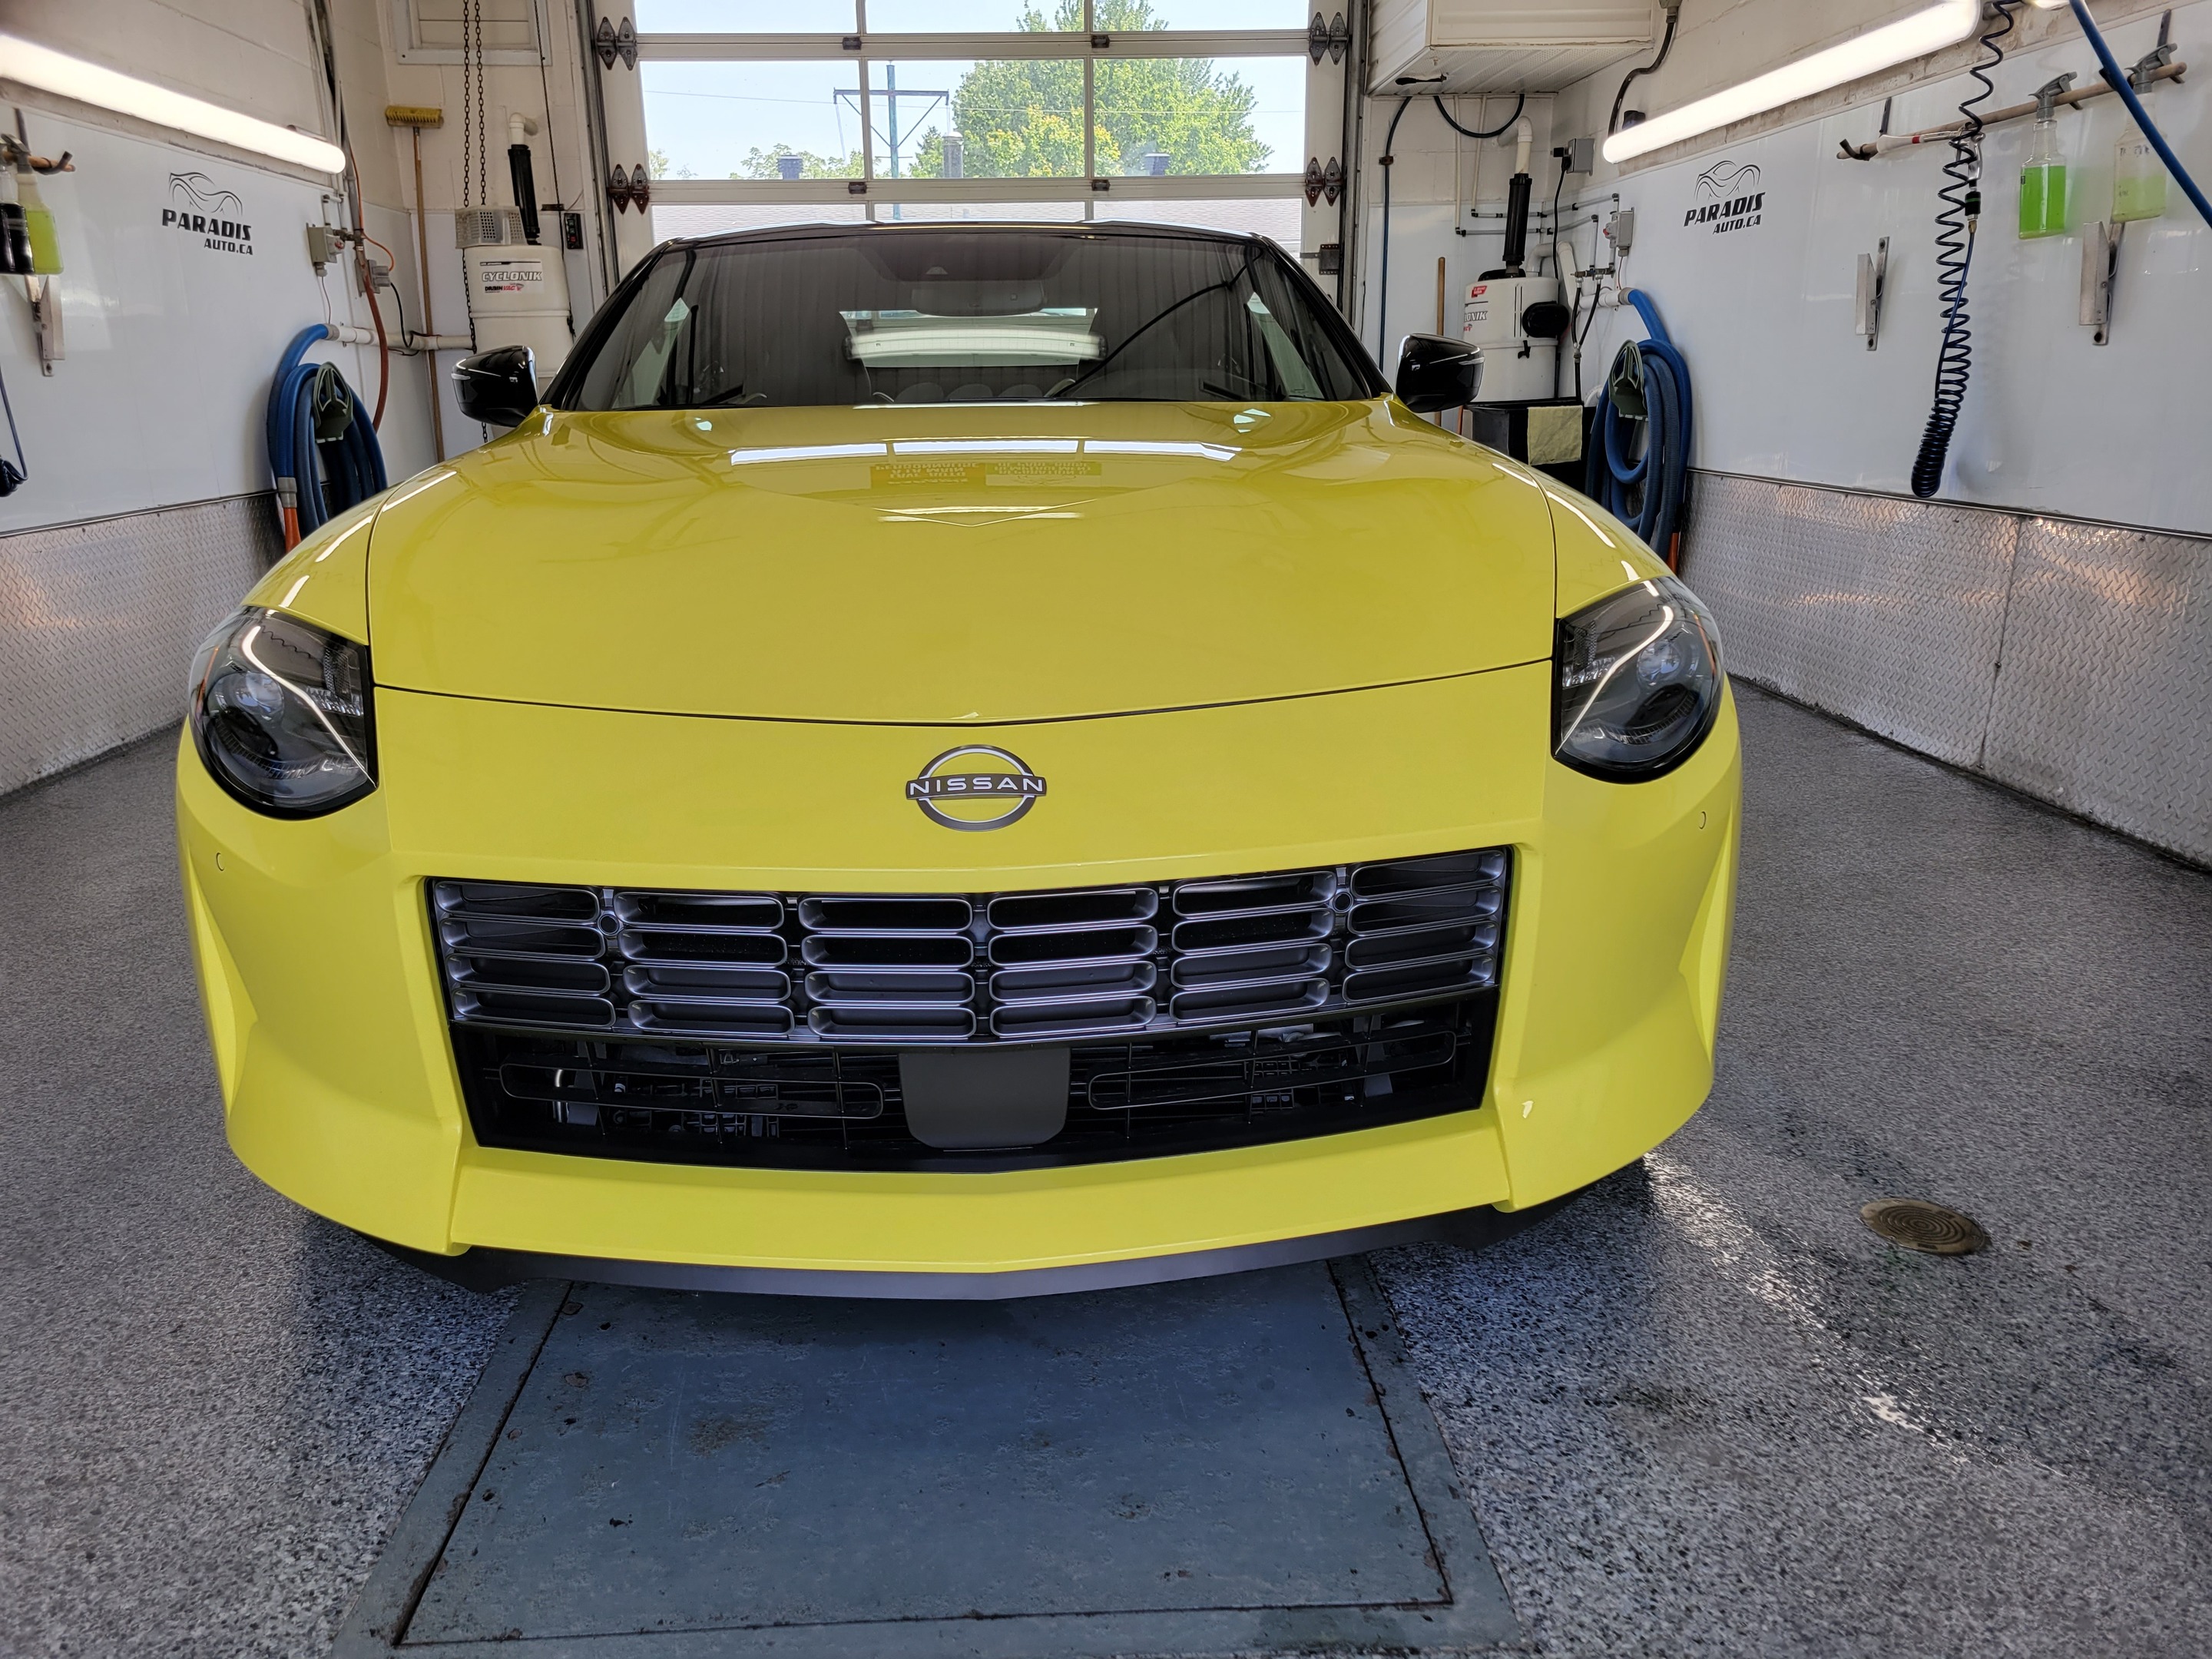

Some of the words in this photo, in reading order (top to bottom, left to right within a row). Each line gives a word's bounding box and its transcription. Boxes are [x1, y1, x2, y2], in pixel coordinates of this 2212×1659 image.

[1683, 191, 1766, 227] PARADIS
[162, 208, 252, 241] PARADIS
[1712, 214, 1762, 235] AUTO.CA
[204, 237, 253, 256] AUTO.CA
[482, 271, 542, 282] CYCLONIK
[909, 777, 1043, 796] NISSAN
